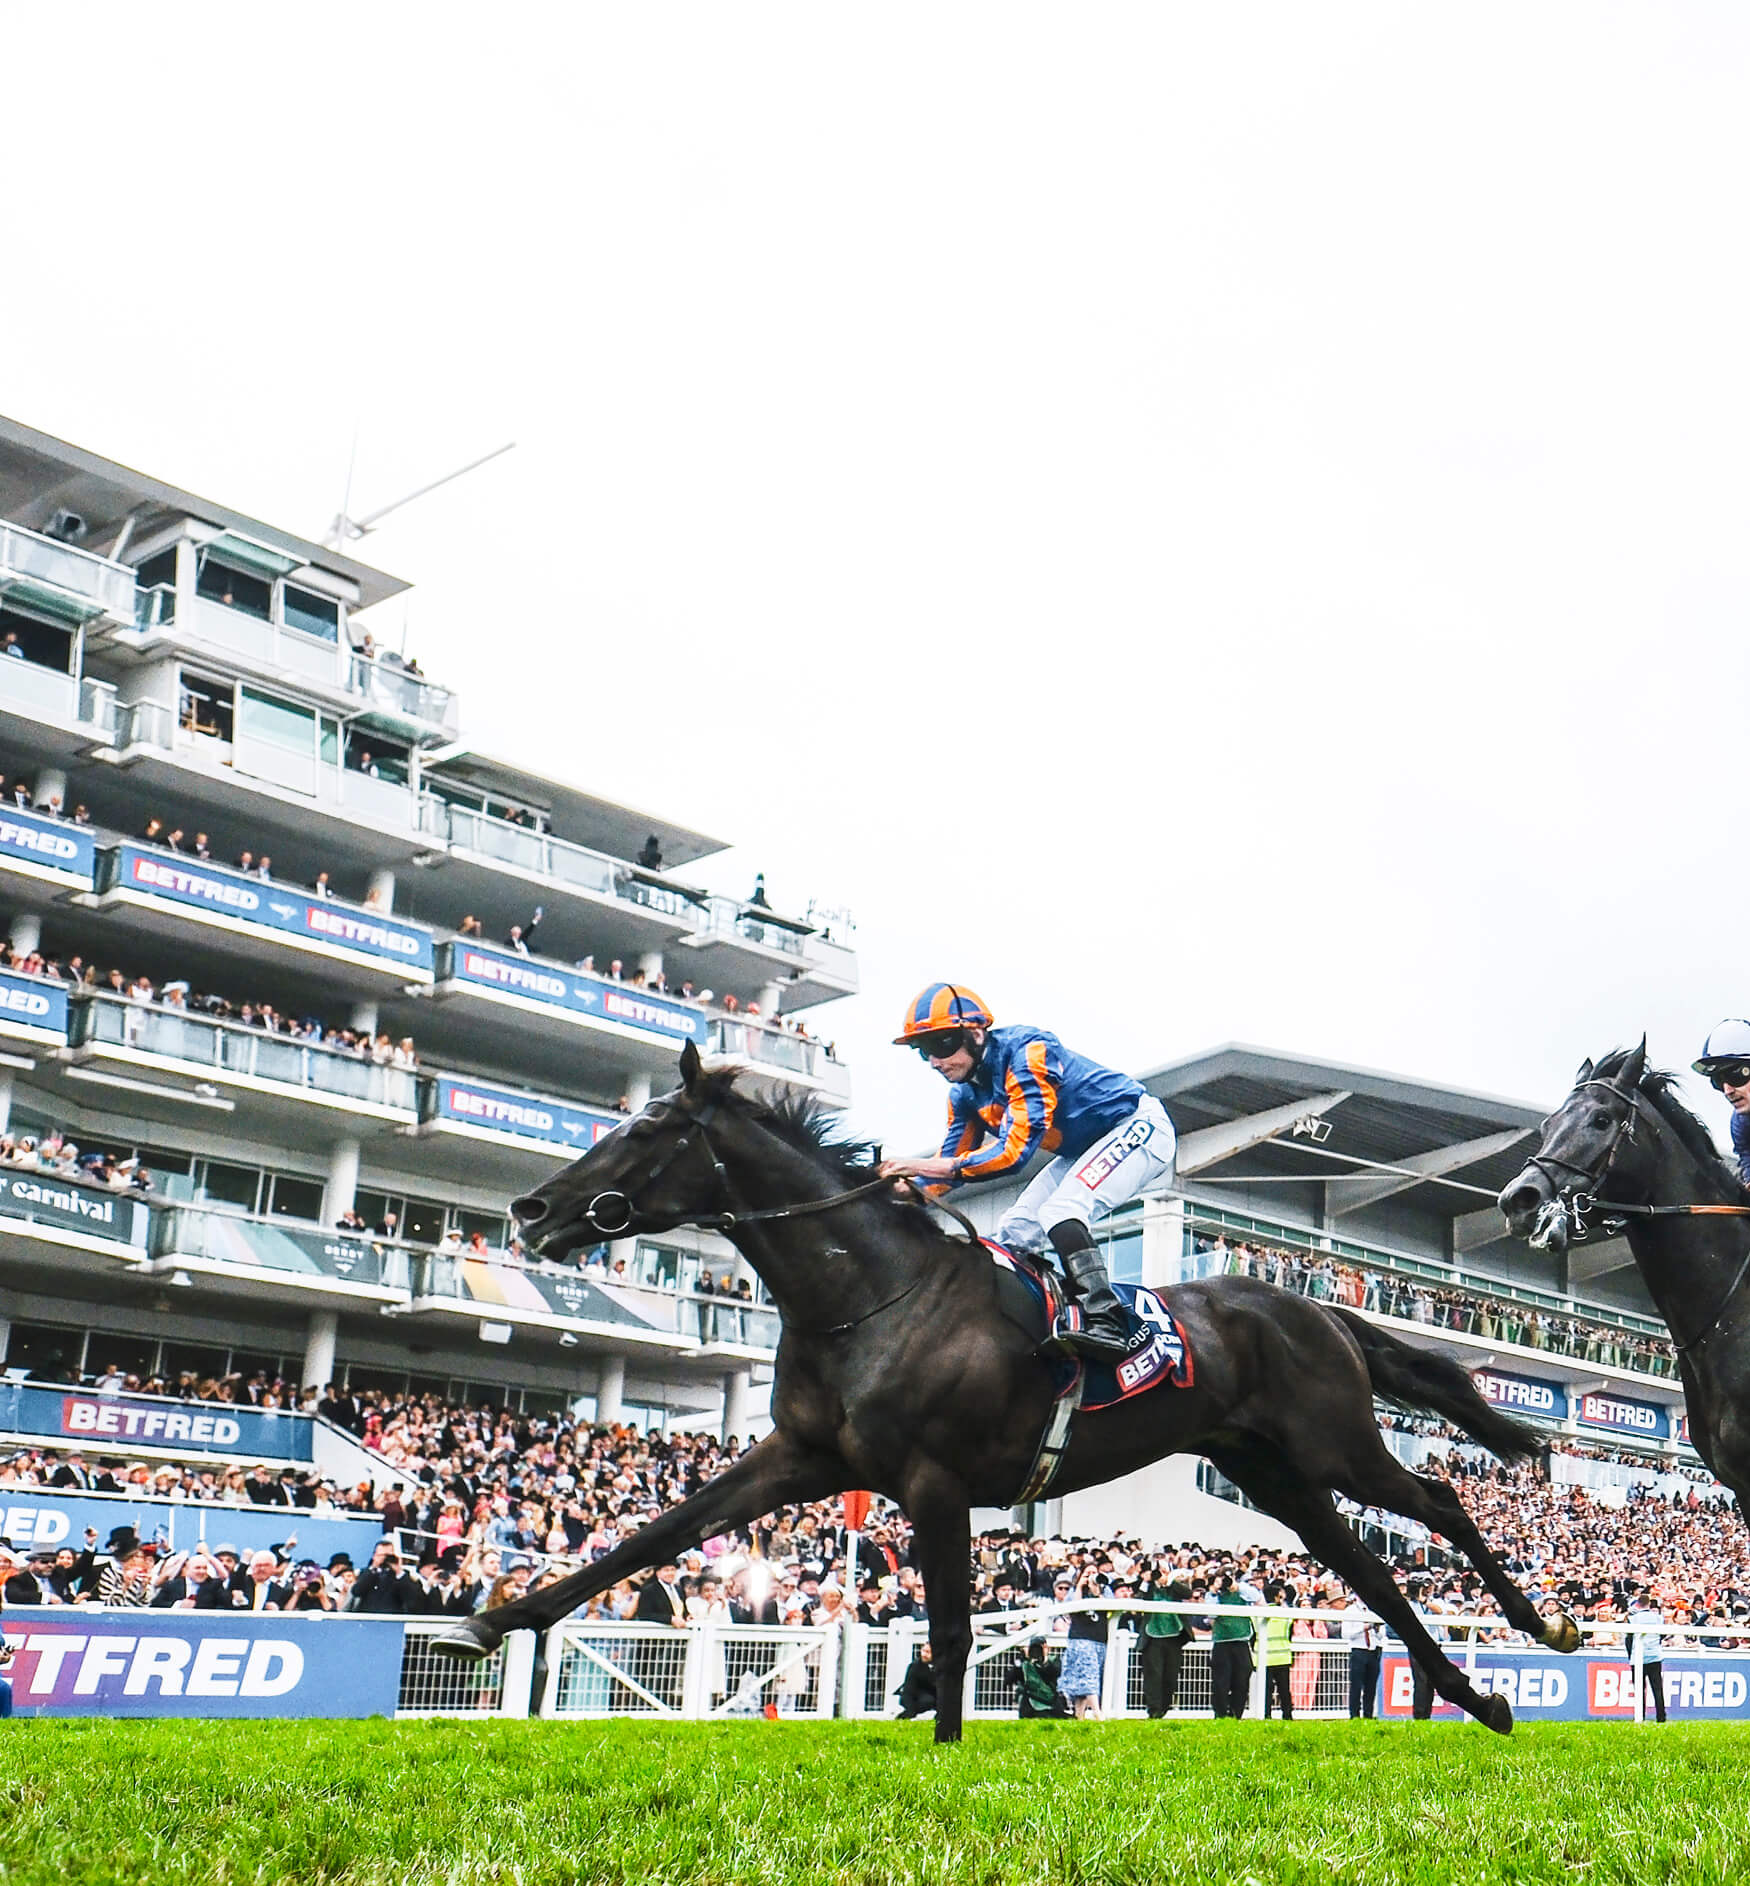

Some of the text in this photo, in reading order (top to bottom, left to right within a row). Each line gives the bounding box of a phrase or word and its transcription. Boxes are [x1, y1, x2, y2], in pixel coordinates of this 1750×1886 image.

[0, 822, 78, 859] FRED
[136, 861, 420, 955] BETFRED BETFRED
[467, 956, 697, 1033] BETFRED BETFRED
[453, 1091, 554, 1130] BETFRED
[12, 1181, 112, 1223] carnival
[1135, 1289, 1171, 1333] 4
[1126, 1321, 1151, 1352] GUS
[1474, 1373, 1554, 1410] BETFRED
[69, 1402, 240, 1445] BETFRED
[1584, 1396, 1656, 1430] BETFRED
[0, 1507, 70, 1543] ED
[1390, 1667, 1568, 1708] BFRED
[1594, 1669, 1747, 1708] BEFRED
